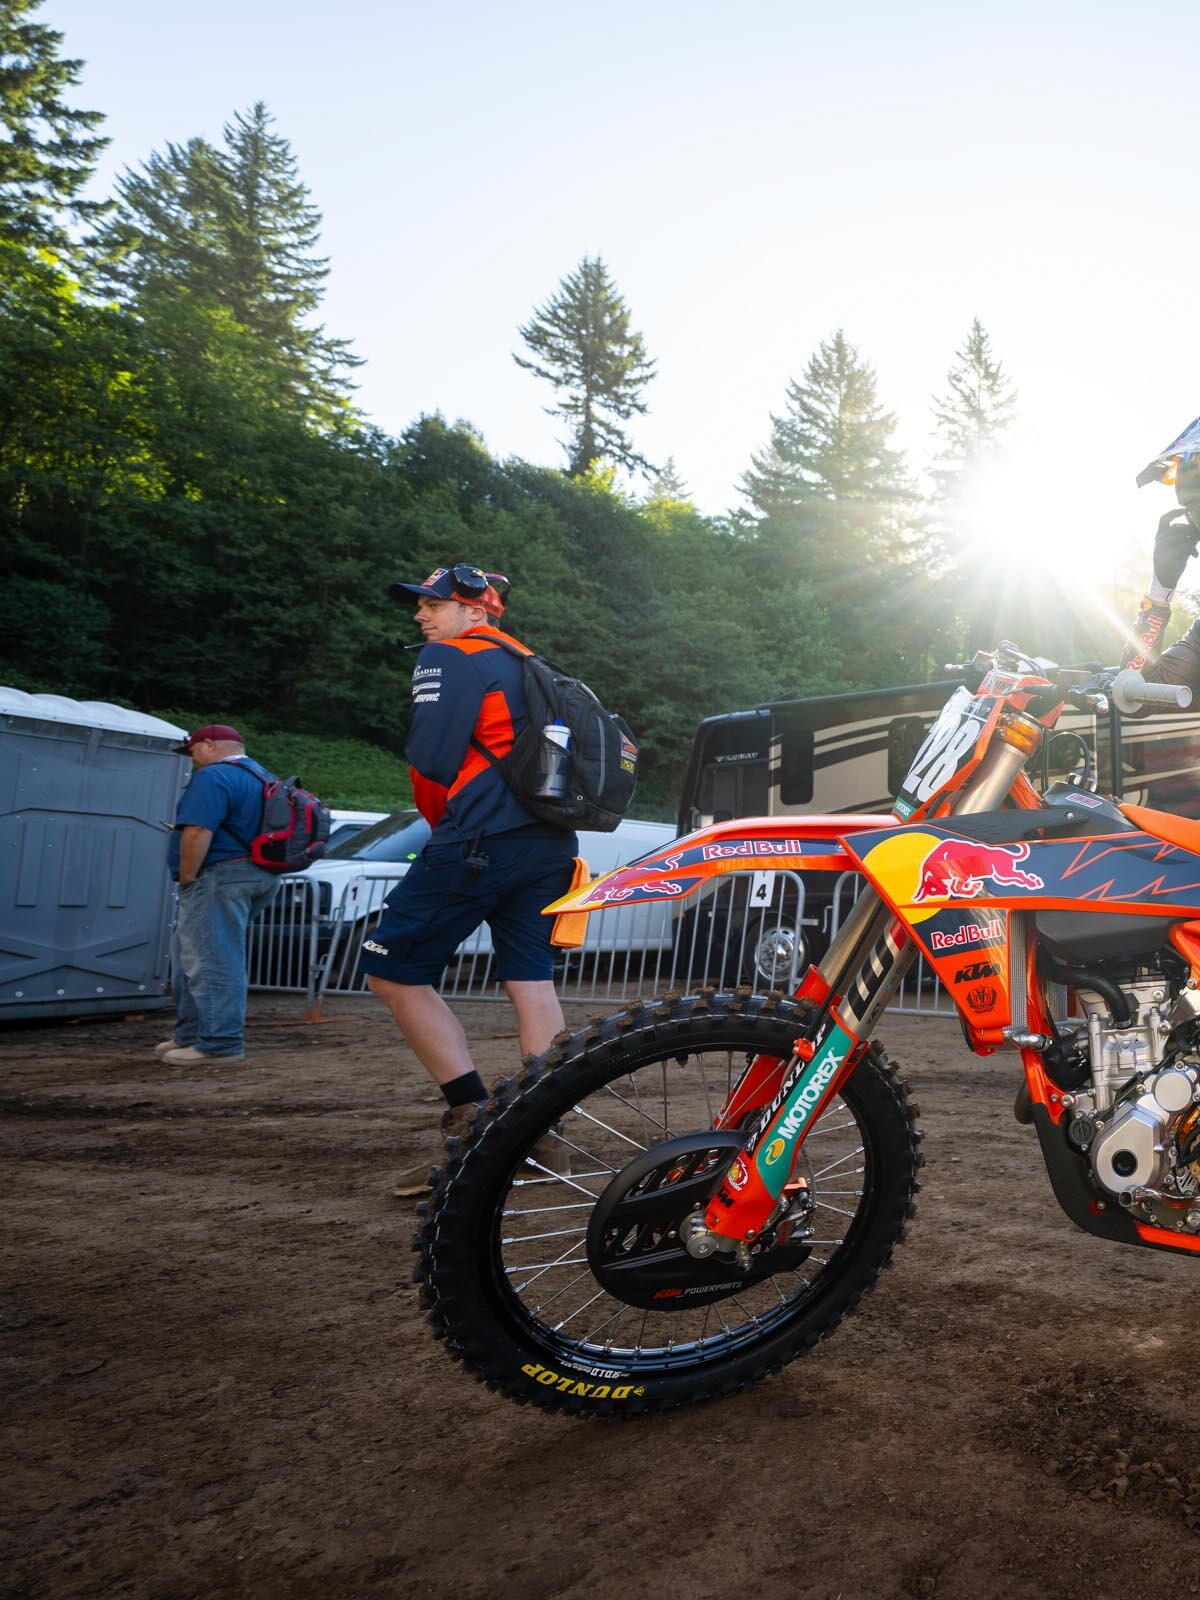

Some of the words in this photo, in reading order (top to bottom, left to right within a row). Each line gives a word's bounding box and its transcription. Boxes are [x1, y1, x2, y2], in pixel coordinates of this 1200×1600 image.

[703, 840, 752, 860] Red
[754, 839, 802, 854] Bull
[351, 886, 358, 901] 1
[756, 884, 767, 900] 4
[931, 926, 966, 950] Red
[967, 919, 1002, 942] Bull
[954, 961, 1001, 984] KTM
[760, 1023, 826, 1132] DUNLP
[777, 1049, 845, 1140] MOTOREX
[653, 1288, 683, 1300] KTM
[685, 1281, 743, 1296] POWERPARTS
[521, 1363, 634, 1399] DUNLOP
